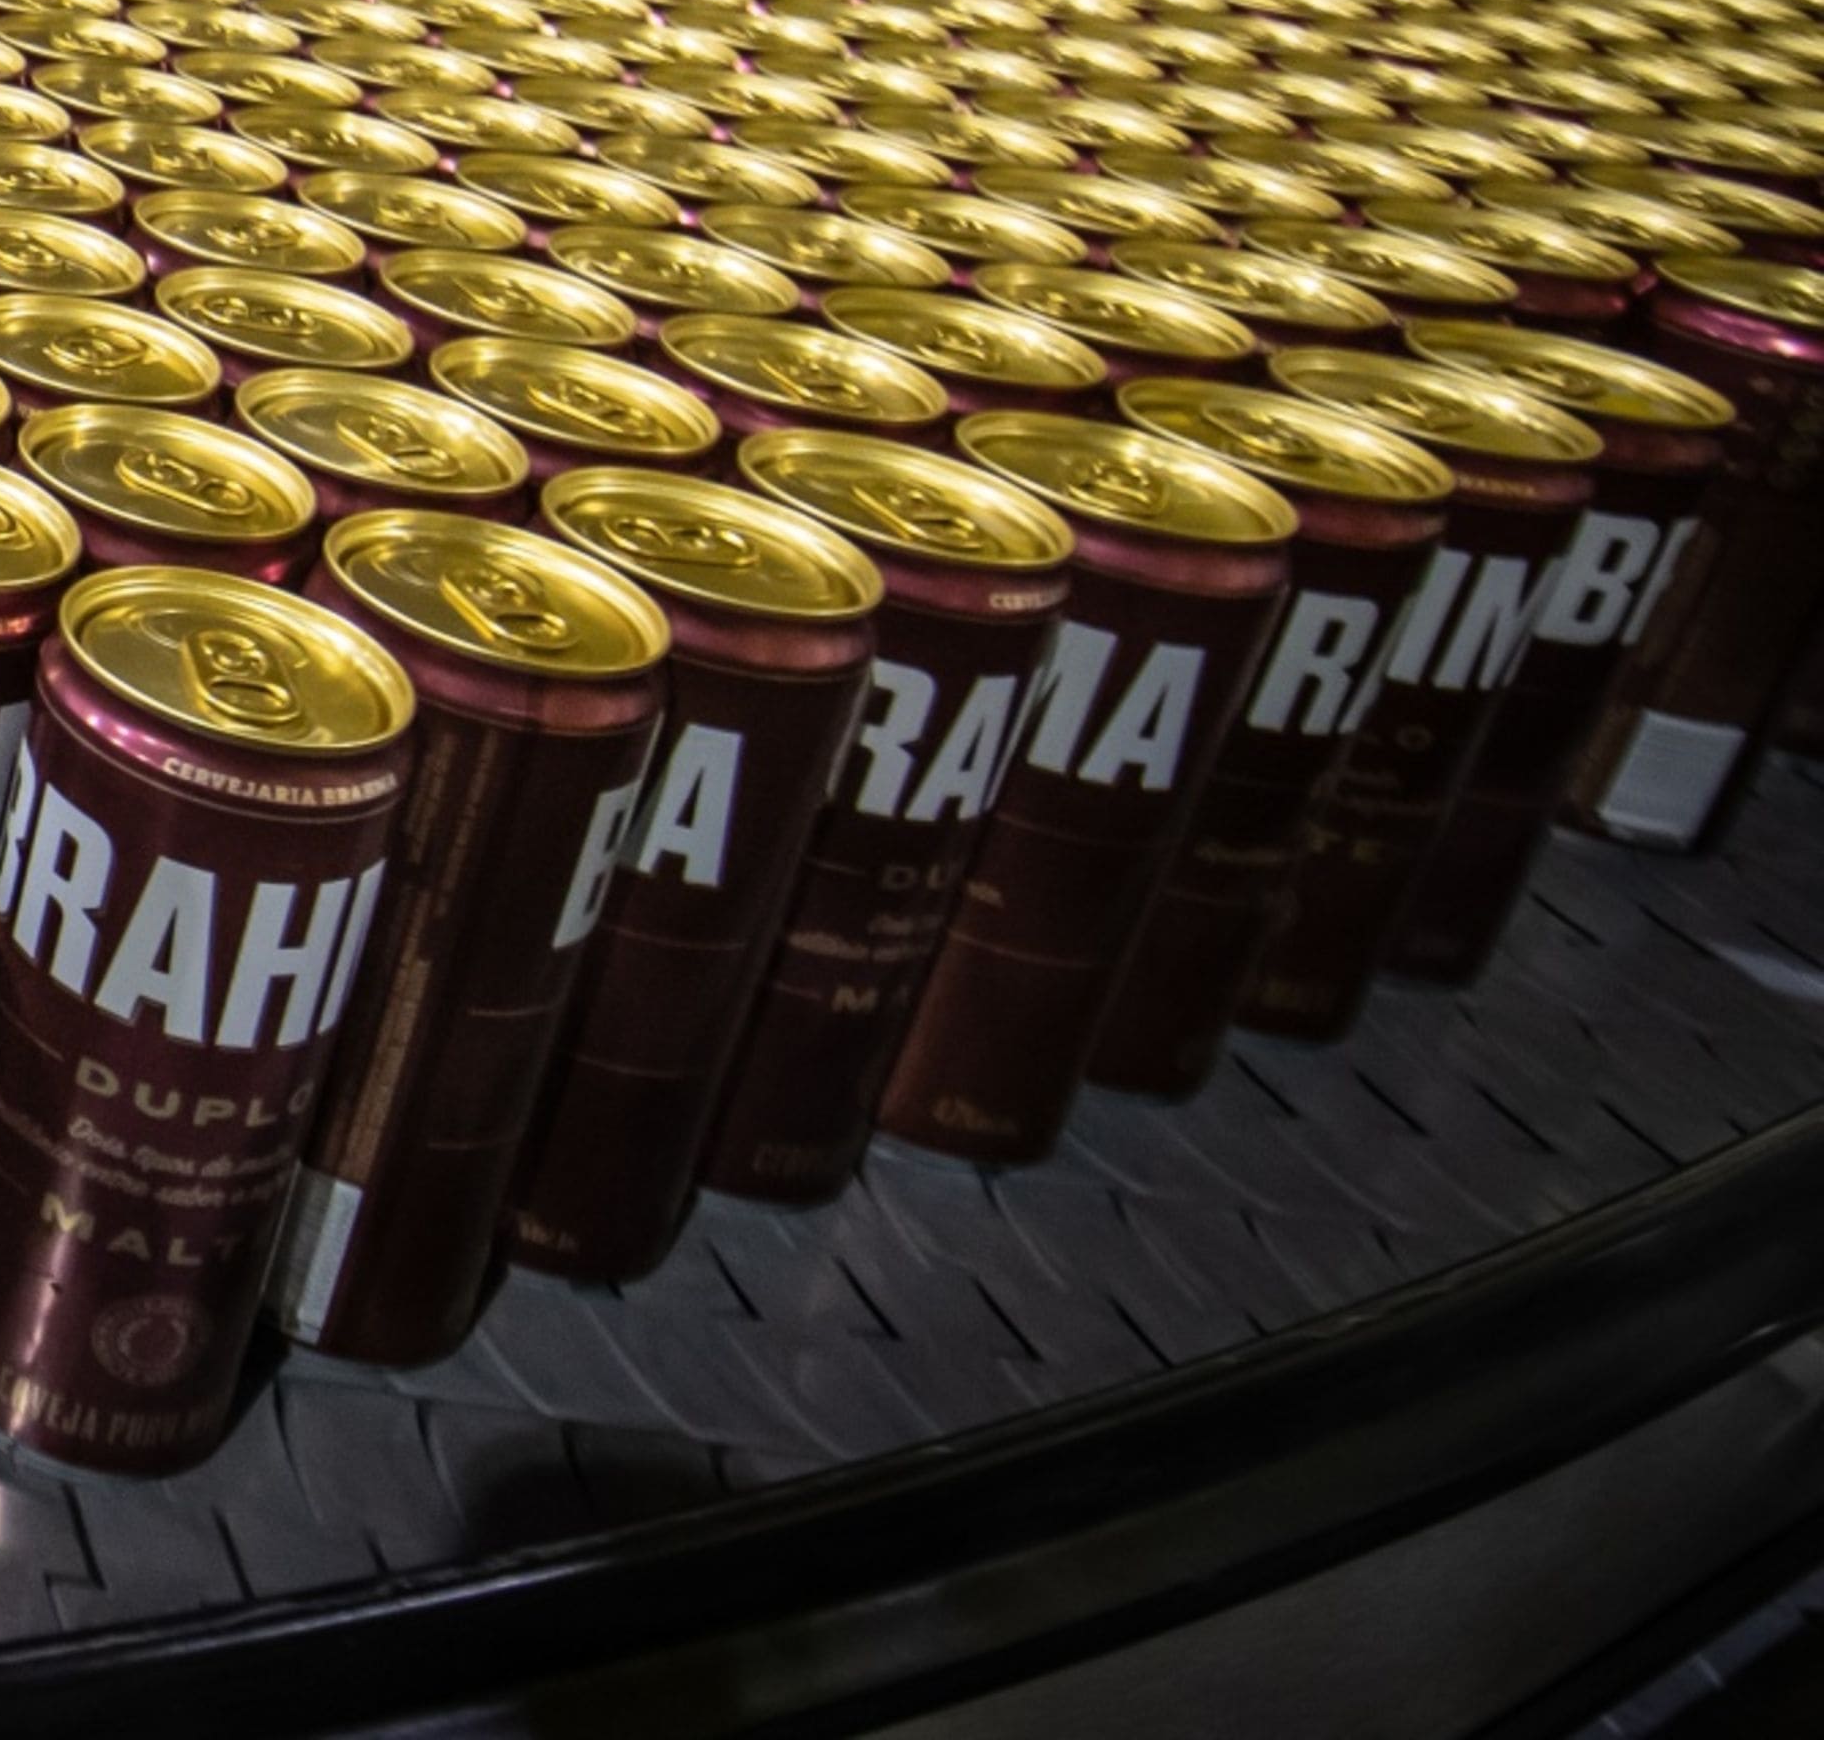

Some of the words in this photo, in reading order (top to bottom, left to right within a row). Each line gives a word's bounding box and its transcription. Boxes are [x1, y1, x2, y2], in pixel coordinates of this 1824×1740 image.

[828, 656, 1038, 823] RA
[161, 756, 320, 807] CERVEJARIA
[74, 1055, 317, 1128] DUPLO
[40, 1190, 246, 1270] MALT
